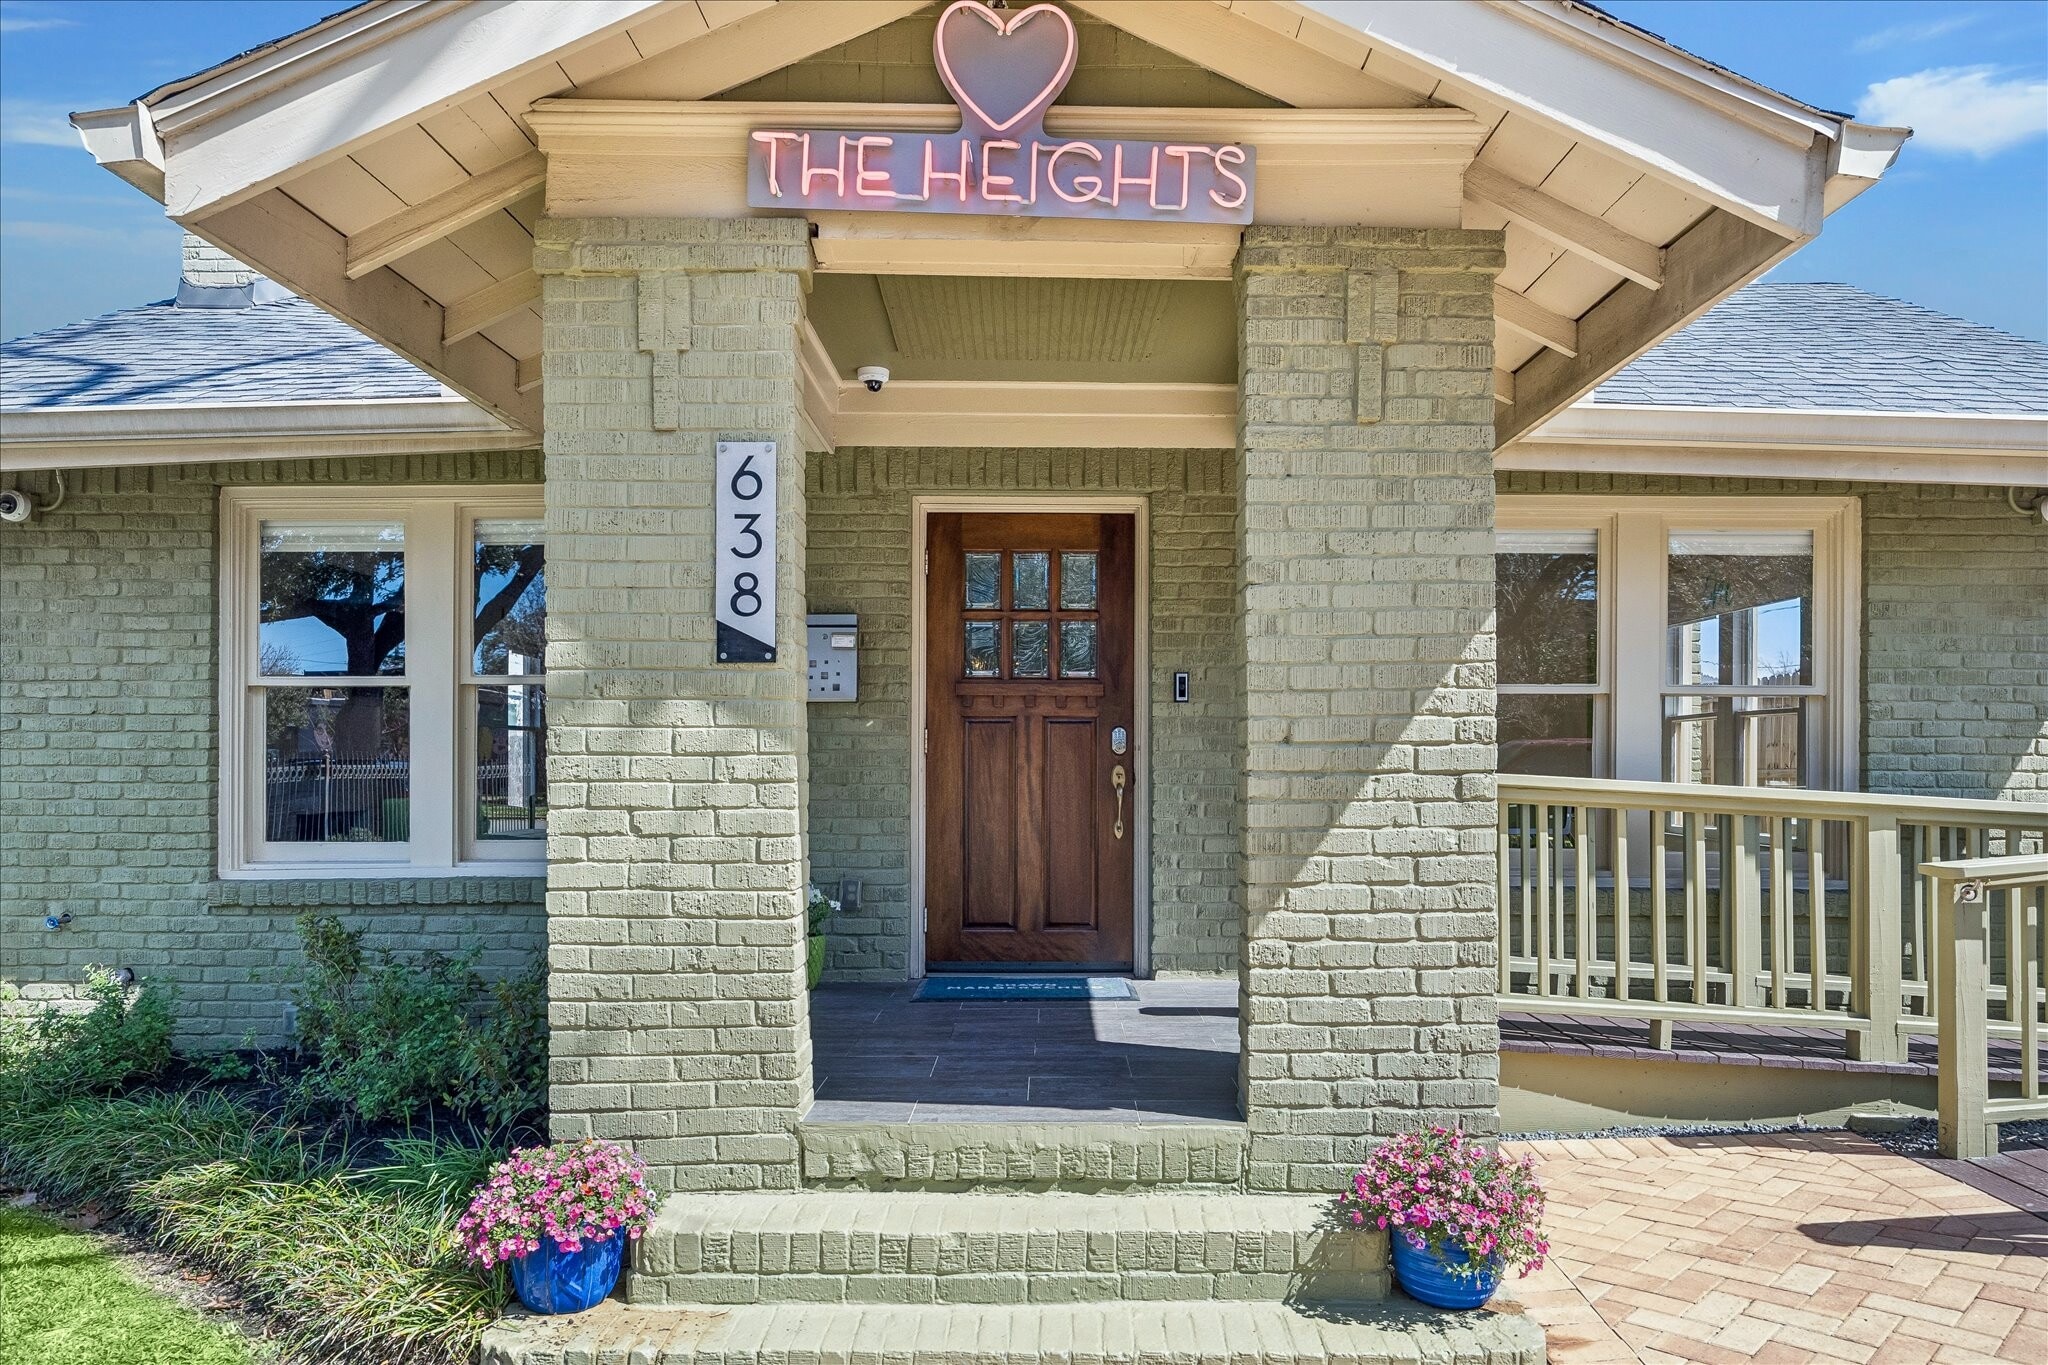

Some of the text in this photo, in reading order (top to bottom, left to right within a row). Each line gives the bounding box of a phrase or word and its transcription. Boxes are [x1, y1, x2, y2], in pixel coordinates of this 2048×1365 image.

[751, 131, 1246, 208] THE HEIGHTS
[730, 455, 763, 617] 638
